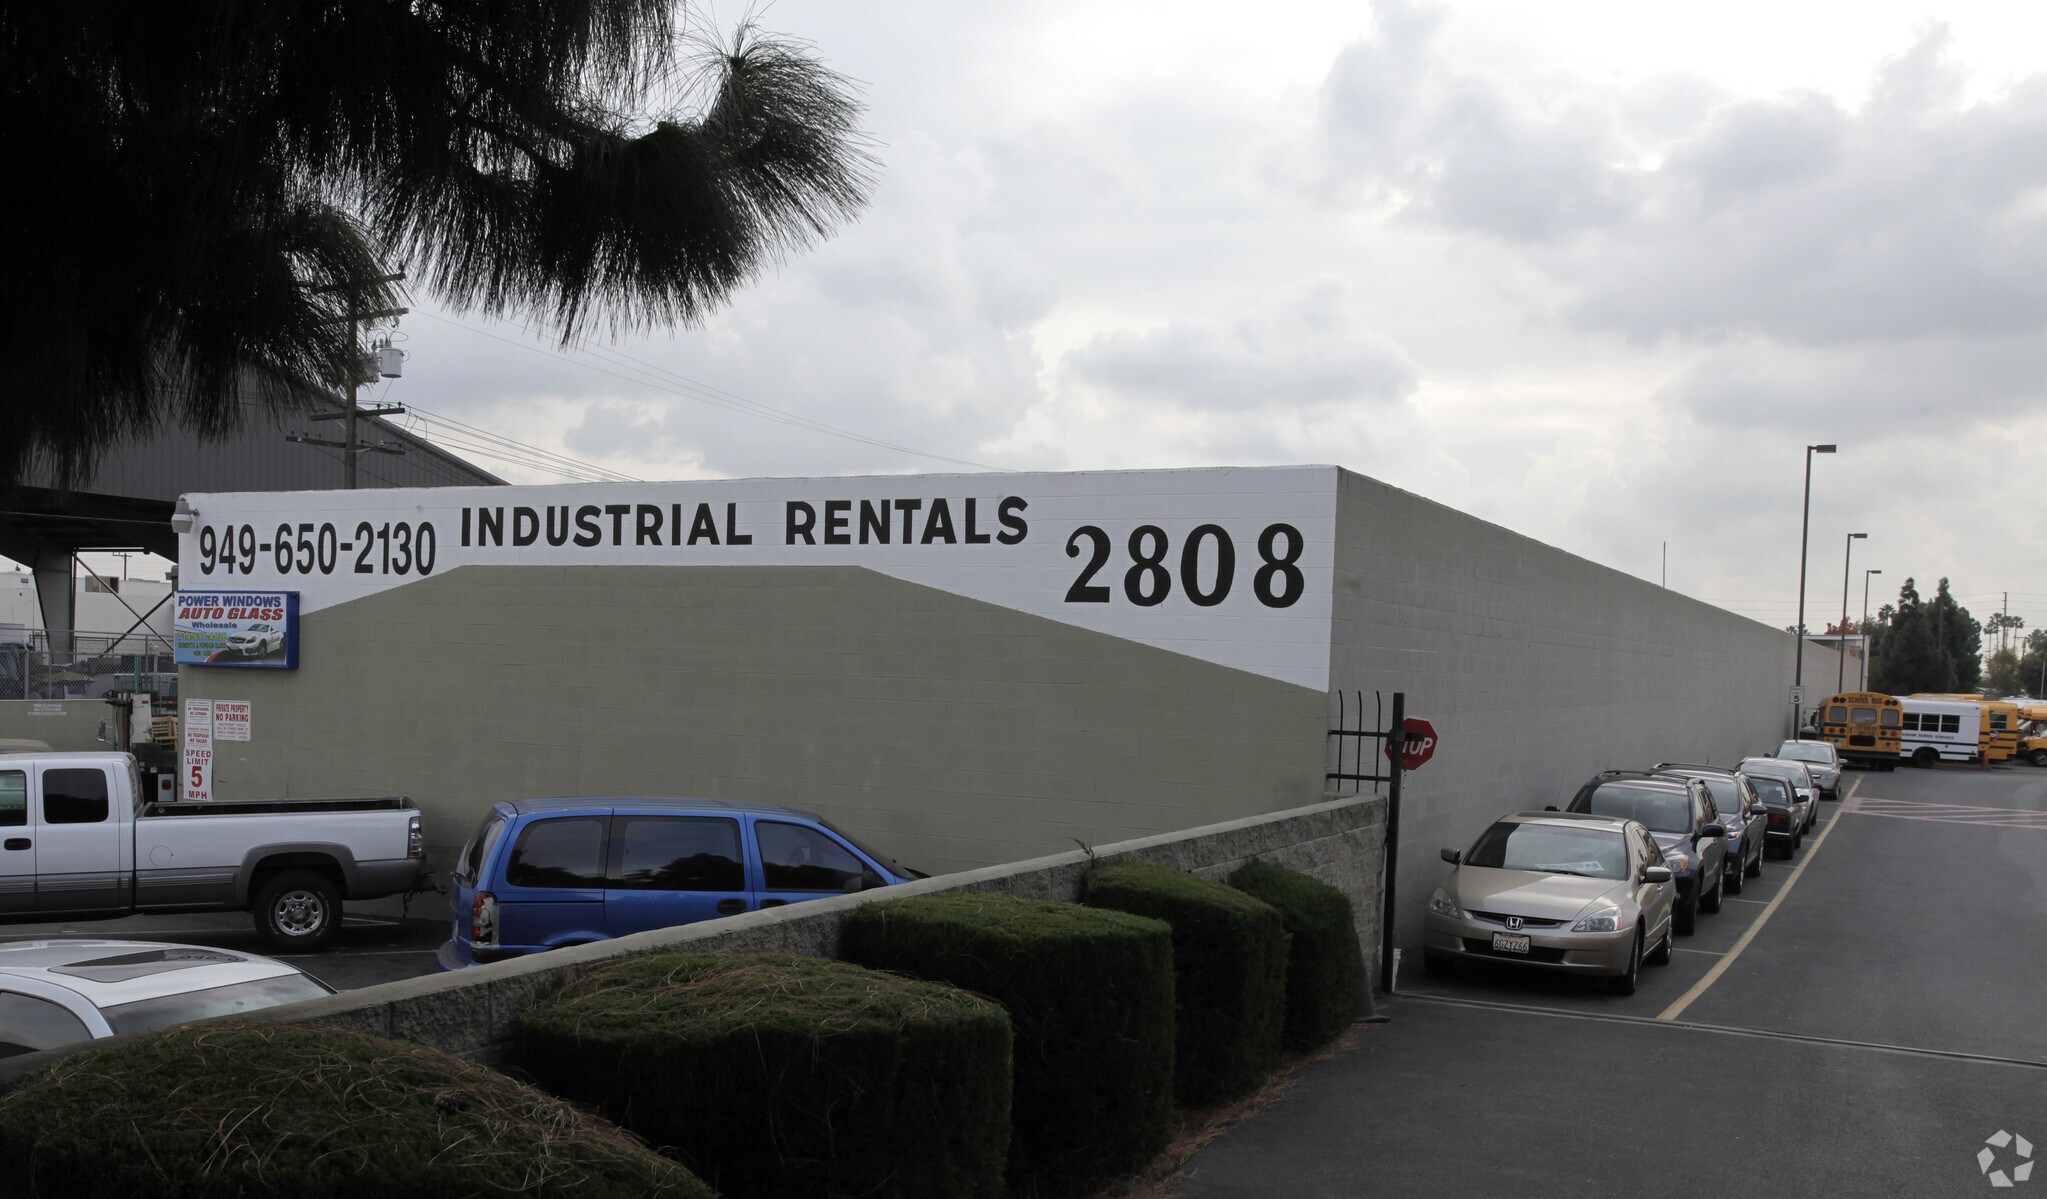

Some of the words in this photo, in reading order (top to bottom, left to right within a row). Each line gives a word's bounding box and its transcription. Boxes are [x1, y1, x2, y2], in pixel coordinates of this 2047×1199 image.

[462, 503, 752, 547] INDUSTRIAL
[786, 496, 1028, 545] RENTALS
[200, 522, 435, 575] 949-650-2130
[1065, 523, 1304, 608] 2808
[178, 595, 219, 607] POWER
[222, 595, 281, 608] WINDOWS
[178, 607, 224, 620] AUTO
[227, 607, 284, 621] GLASS
[191, 621, 237, 629] Wholesale
[1793, 695, 1800, 703] 5
[1847, 696, 1869, 705] SCHOOL
[1871, 697, 1883, 706] BUS
[216, 704, 229, 712] PRIVATE
[231, 705, 248, 713] PROPERTY
[216, 713, 223, 721] NO
[225, 713, 249, 723] PARKING
[1390, 736, 1434, 756] TOP
[185, 749, 211, 757] SPEED
[190, 765, 203, 788] 5
[188, 790, 208, 800] MPH
